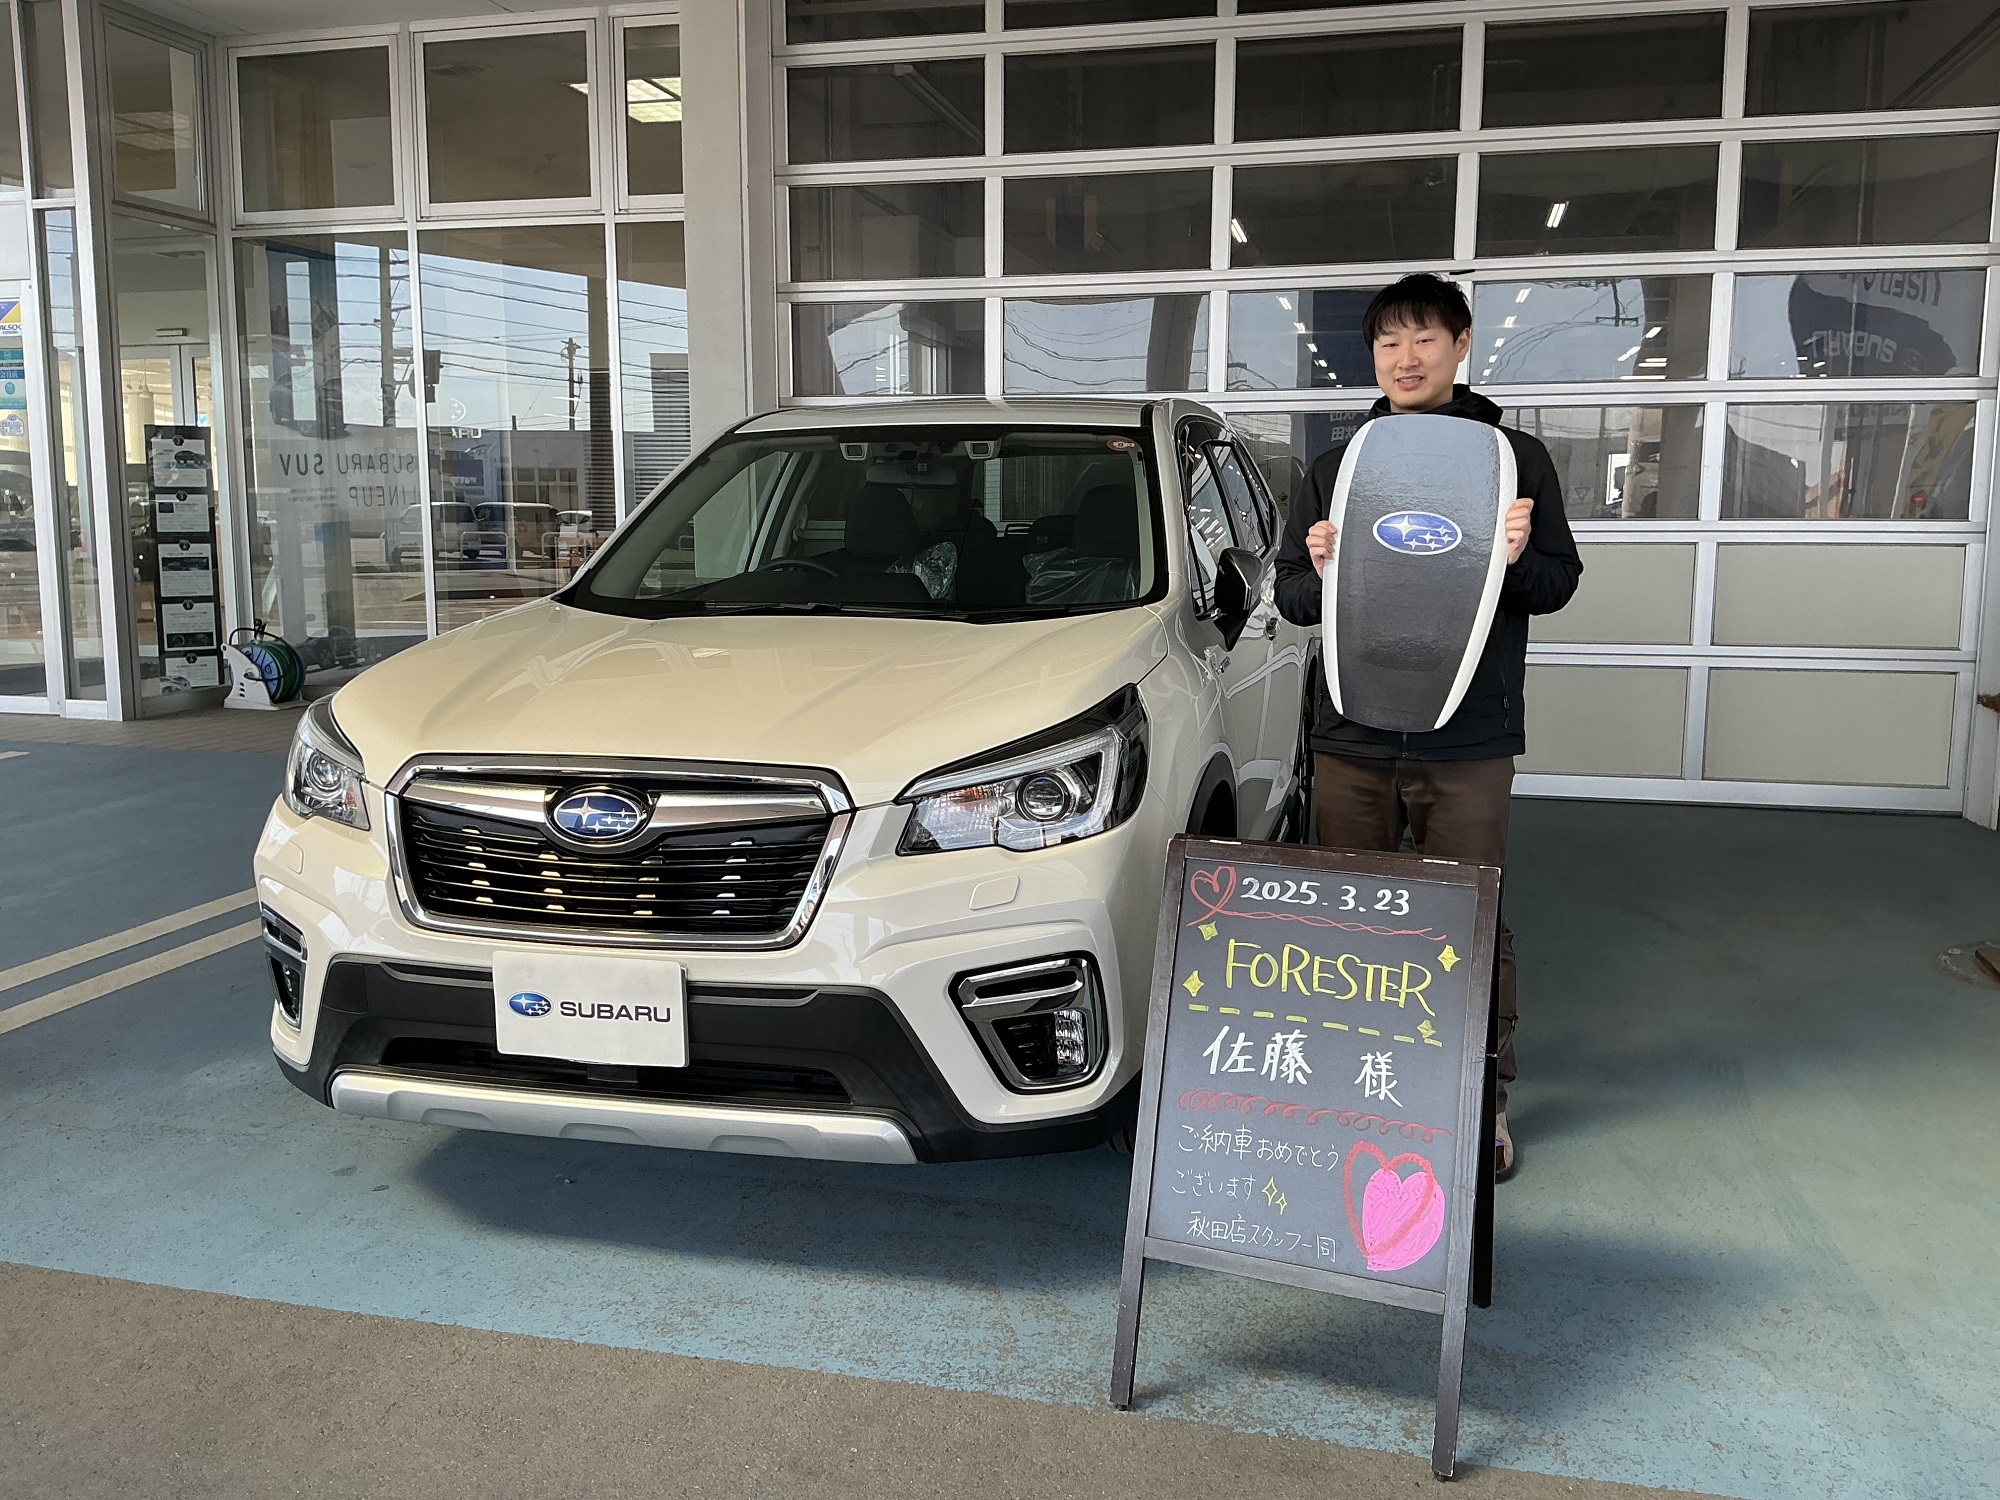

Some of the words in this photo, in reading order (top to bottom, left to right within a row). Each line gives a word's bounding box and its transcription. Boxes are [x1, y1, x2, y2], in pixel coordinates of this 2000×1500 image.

[559, 1001, 672, 1023] SUBARU
[1202, 1025, 1313, 1085] 佐藤
[1353, 1051, 1404, 1108] 様
[1178, 1123, 1339, 1172] ご納車おめでとう
